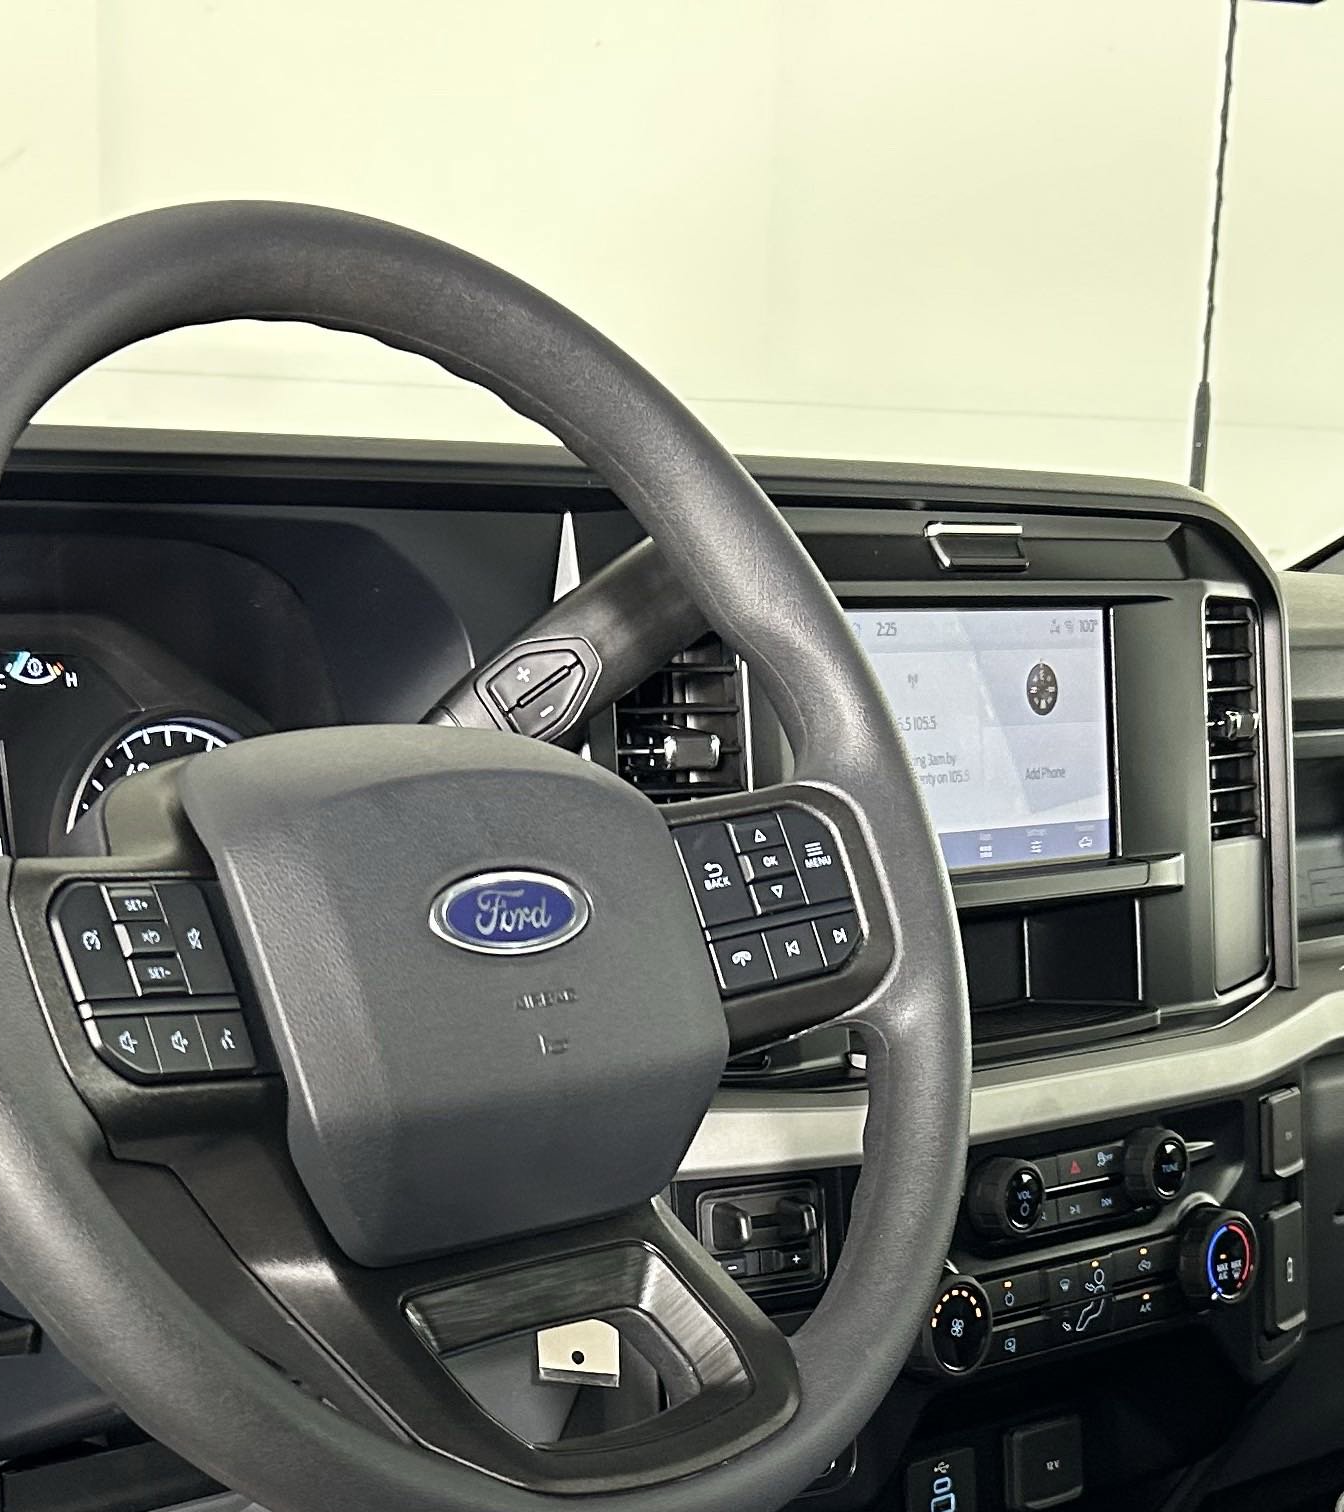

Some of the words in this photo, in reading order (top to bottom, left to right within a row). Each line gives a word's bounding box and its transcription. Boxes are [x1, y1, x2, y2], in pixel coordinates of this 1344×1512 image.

[876, 621, 897, 637] 2:25
[64, 671, 79, 688] H
[1024, 767, 1042, 780] Add
[1042, 766, 1066, 780] Phone
[762, 855, 779, 868] OK
[804, 855, 832, 869] MENU
[703, 876, 732, 891] BACK
[475, 889, 552, 936] Ford
[1161, 1162, 1180, 1174] TUNE
[1016, 1189, 1032, 1200] VOL
[1139, 1302, 1152, 1313] A/C
